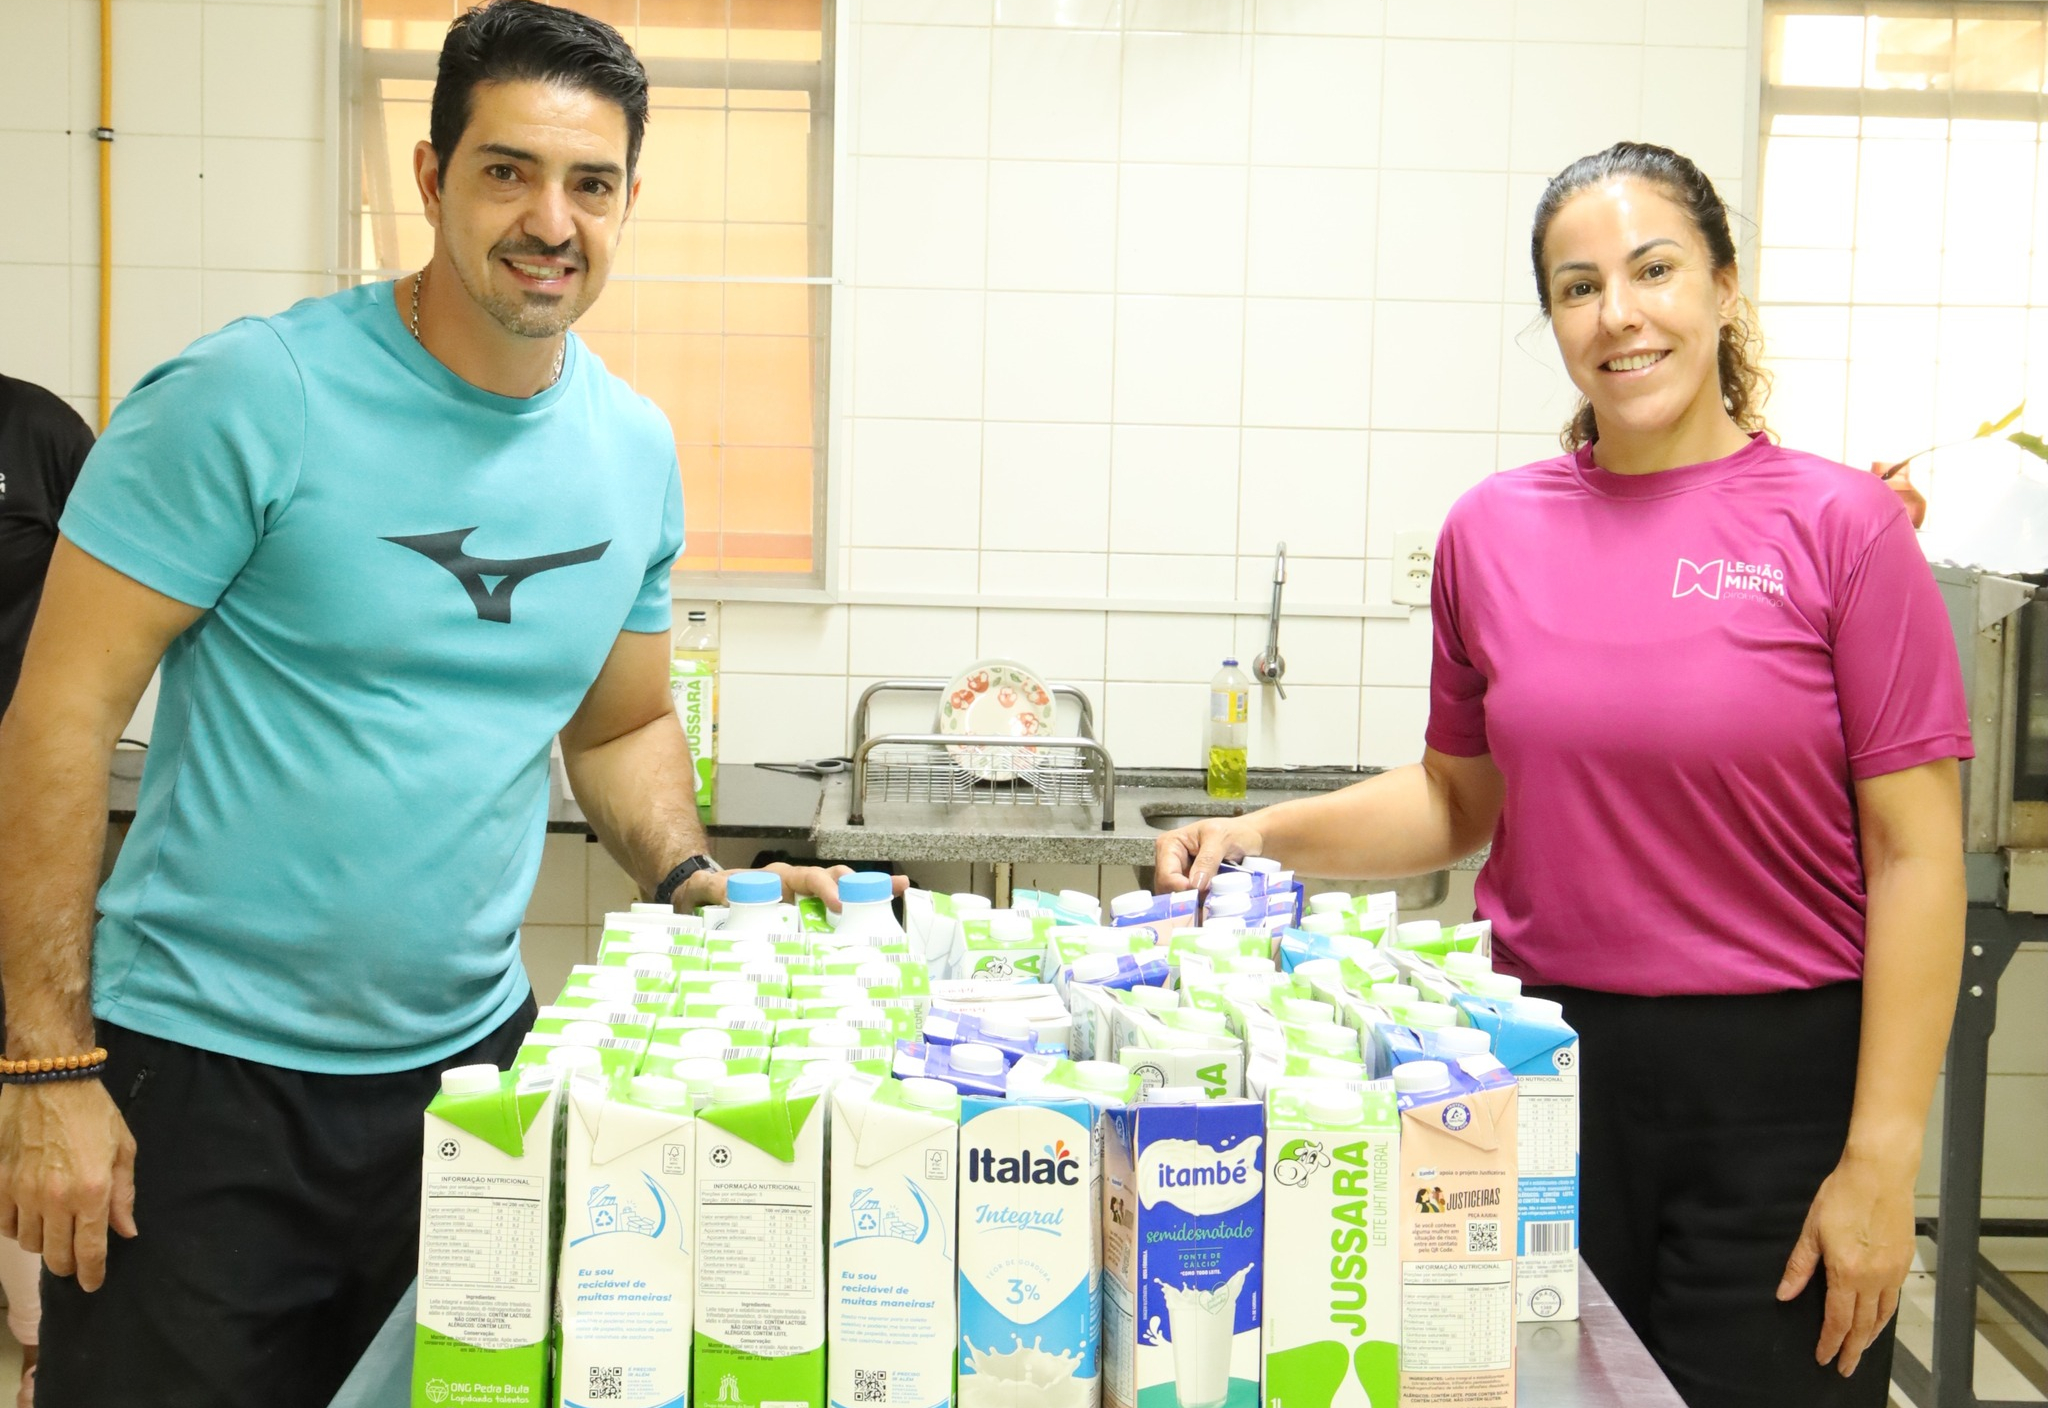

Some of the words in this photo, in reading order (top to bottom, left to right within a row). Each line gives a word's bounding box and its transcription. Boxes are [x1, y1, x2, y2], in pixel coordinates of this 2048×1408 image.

[1726, 560, 1784, 580] LEGIÃO
[1724, 574, 1785, 597] MIRIM
[686, 679, 702, 756] JUSSARA
[969, 1147, 1080, 1186] Italac
[1158, 1158, 1248, 1188] itambé
[1372, 1141, 1388, 1192] INTEGRAL
[1459, 1169, 1479, 1177] projeto
[487, 1177, 530, 1185] NUTRICIONAL
[1372, 1194, 1388, 1217] UHT
[1446, 1187, 1501, 1211] JUSTICEIRAS
[975, 1203, 1065, 1230] Integral
[1146, 1220, 1254, 1244] semidesnatado
[1330, 1140, 1369, 1337] JUSSARA
[1372, 1218, 1388, 1247] LEITE
[1209, 1252, 1221, 1260] DE
[577, 1280, 631, 1289] reciclável
[632, 1280, 647, 1288] de
[841, 1271, 855, 1279] Eu
[577, 1292, 615, 1301] muitas
[617, 1292, 673, 1302] maneiras!
[841, 1284, 893, 1294] reciclável
[895, 1286, 910, 1295] de
[1006, 1278, 1041, 1305] 3%
[840, 1296, 878, 1306] muitas
[880, 1299, 936, 1309] maneiras!
[450, 1382, 472, 1392] ONG
[474, 1383, 502, 1393] Pedra
[450, 1393, 493, 1405] Lapidando
[495, 1394, 530, 1404] talentos
